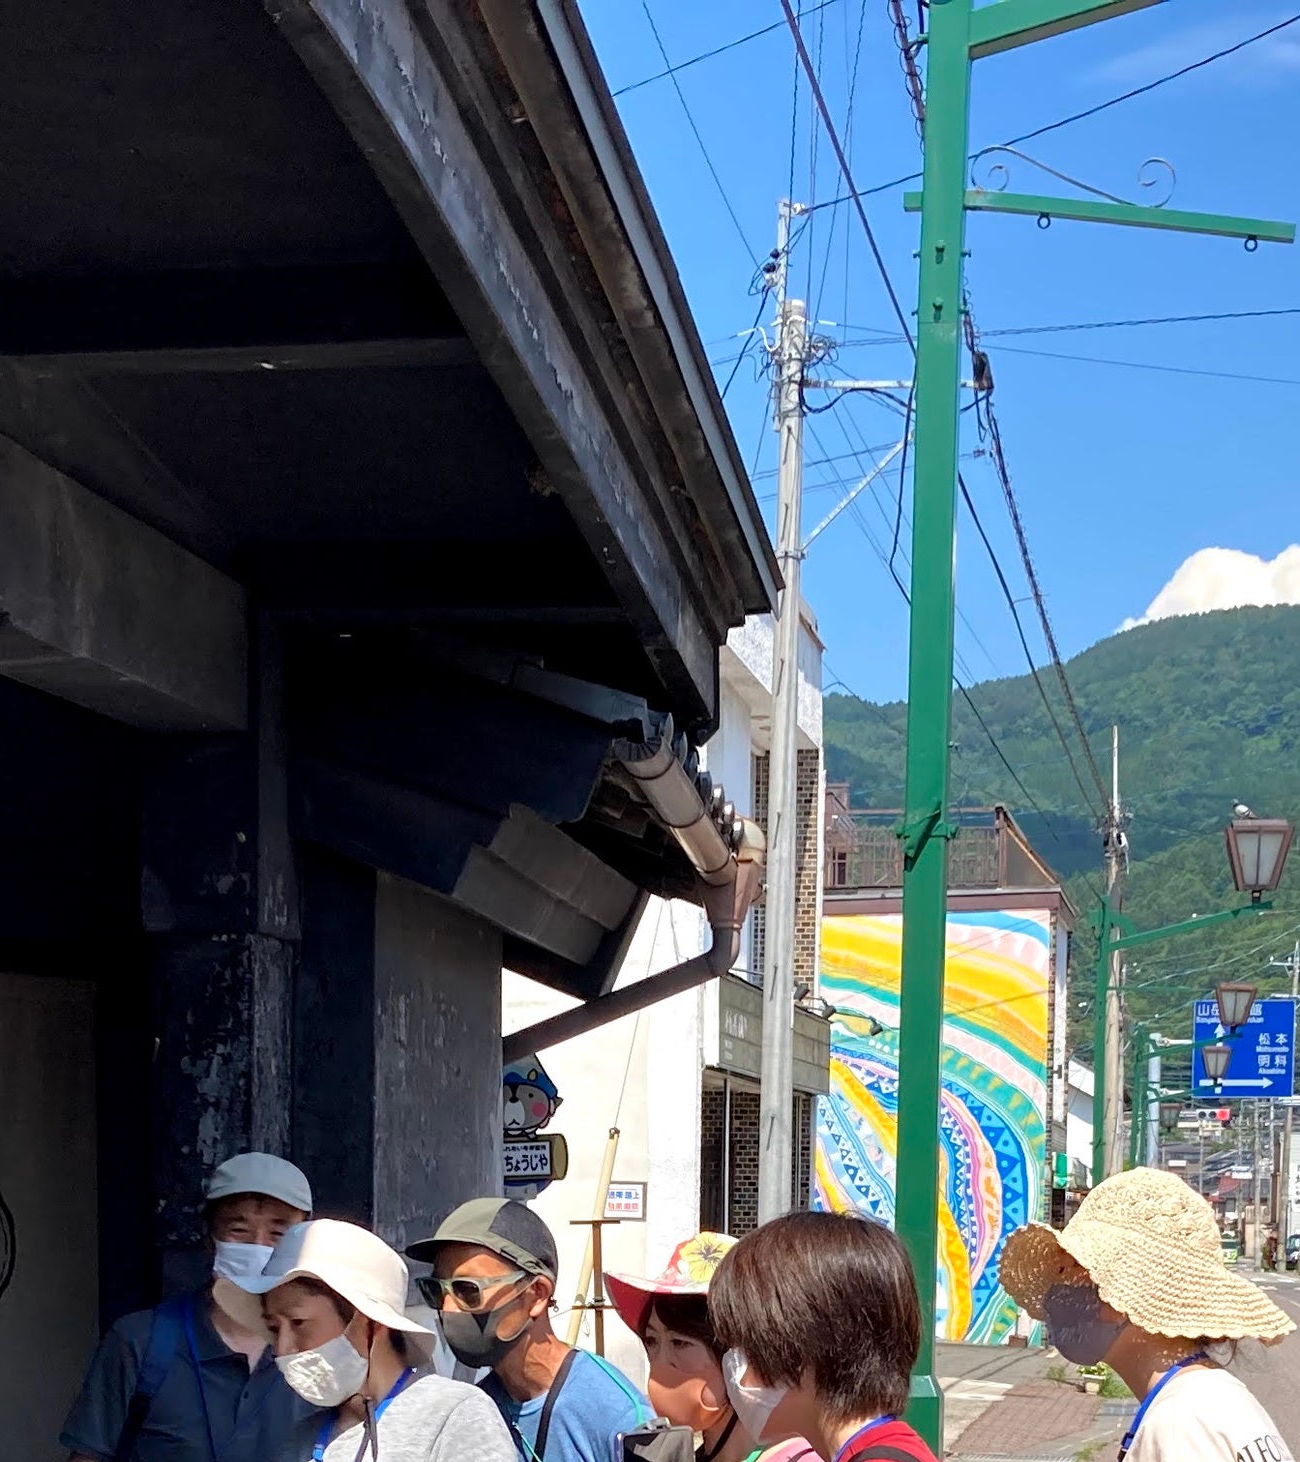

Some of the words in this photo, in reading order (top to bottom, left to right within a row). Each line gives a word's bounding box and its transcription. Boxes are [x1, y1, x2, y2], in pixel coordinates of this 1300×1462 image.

[1258, 1032, 1288, 1046] 松本
[504, 1153, 548, 1172] ちょうじや
